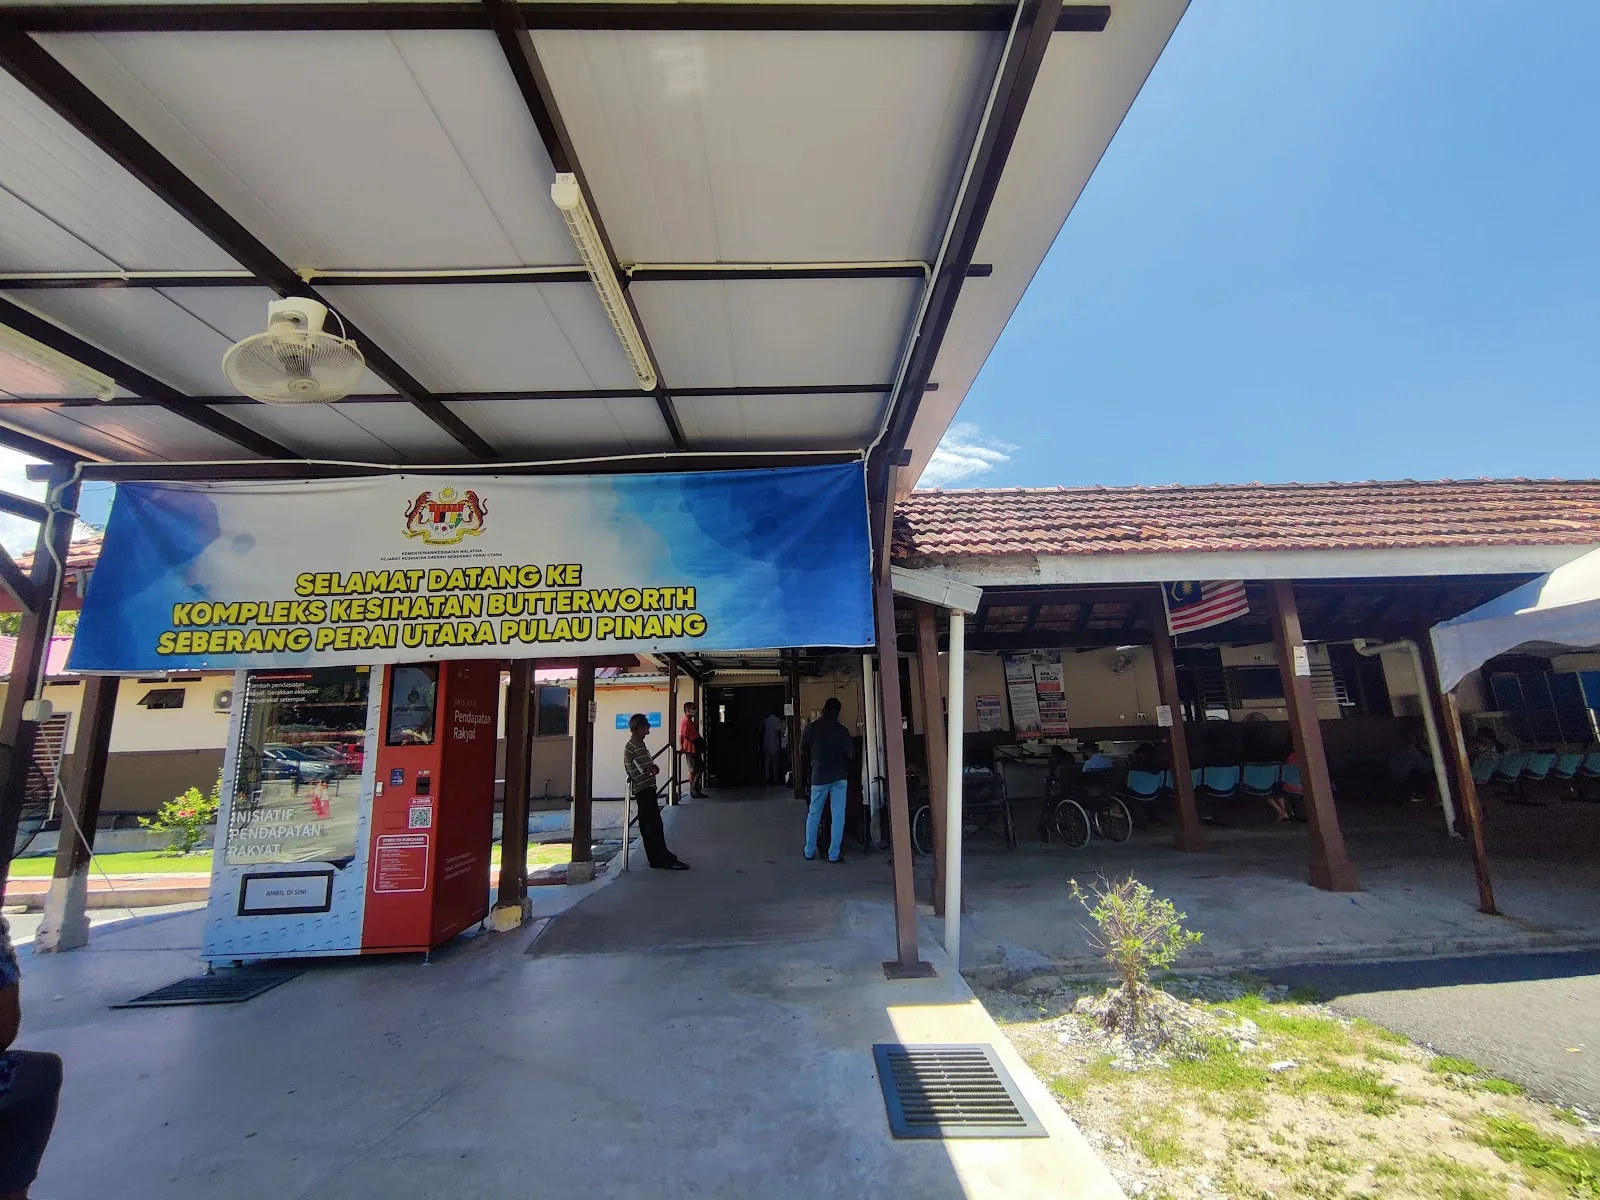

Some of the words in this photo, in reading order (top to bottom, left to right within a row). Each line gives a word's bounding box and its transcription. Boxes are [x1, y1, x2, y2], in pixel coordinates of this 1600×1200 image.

[295, 570, 425, 597] SELAMAT
[427, 565, 542, 591] DATANG
[545, 564, 582, 588] KE
[172, 600, 327, 626] KOMPLEKS
[330, 593, 483, 622] KESIHATAN
[487, 587, 696, 617] BUTTERWORTH
[156, 627, 312, 655] SEBERANG
[314, 624, 399, 652] PERAI
[401, 620, 496, 648] UTARA
[500, 617, 594, 645] PULAU
[596, 613, 707, 641] PINANG
[454, 710, 492, 727] Pendapatan
[453, 726, 477, 742] Rakyat
[231, 808, 294, 823] INISIATIF
[229, 824, 321, 841] PENDAPATAN
[227, 843, 282, 857] RAKYAT
[265, 889, 285, 897] AMBIL
